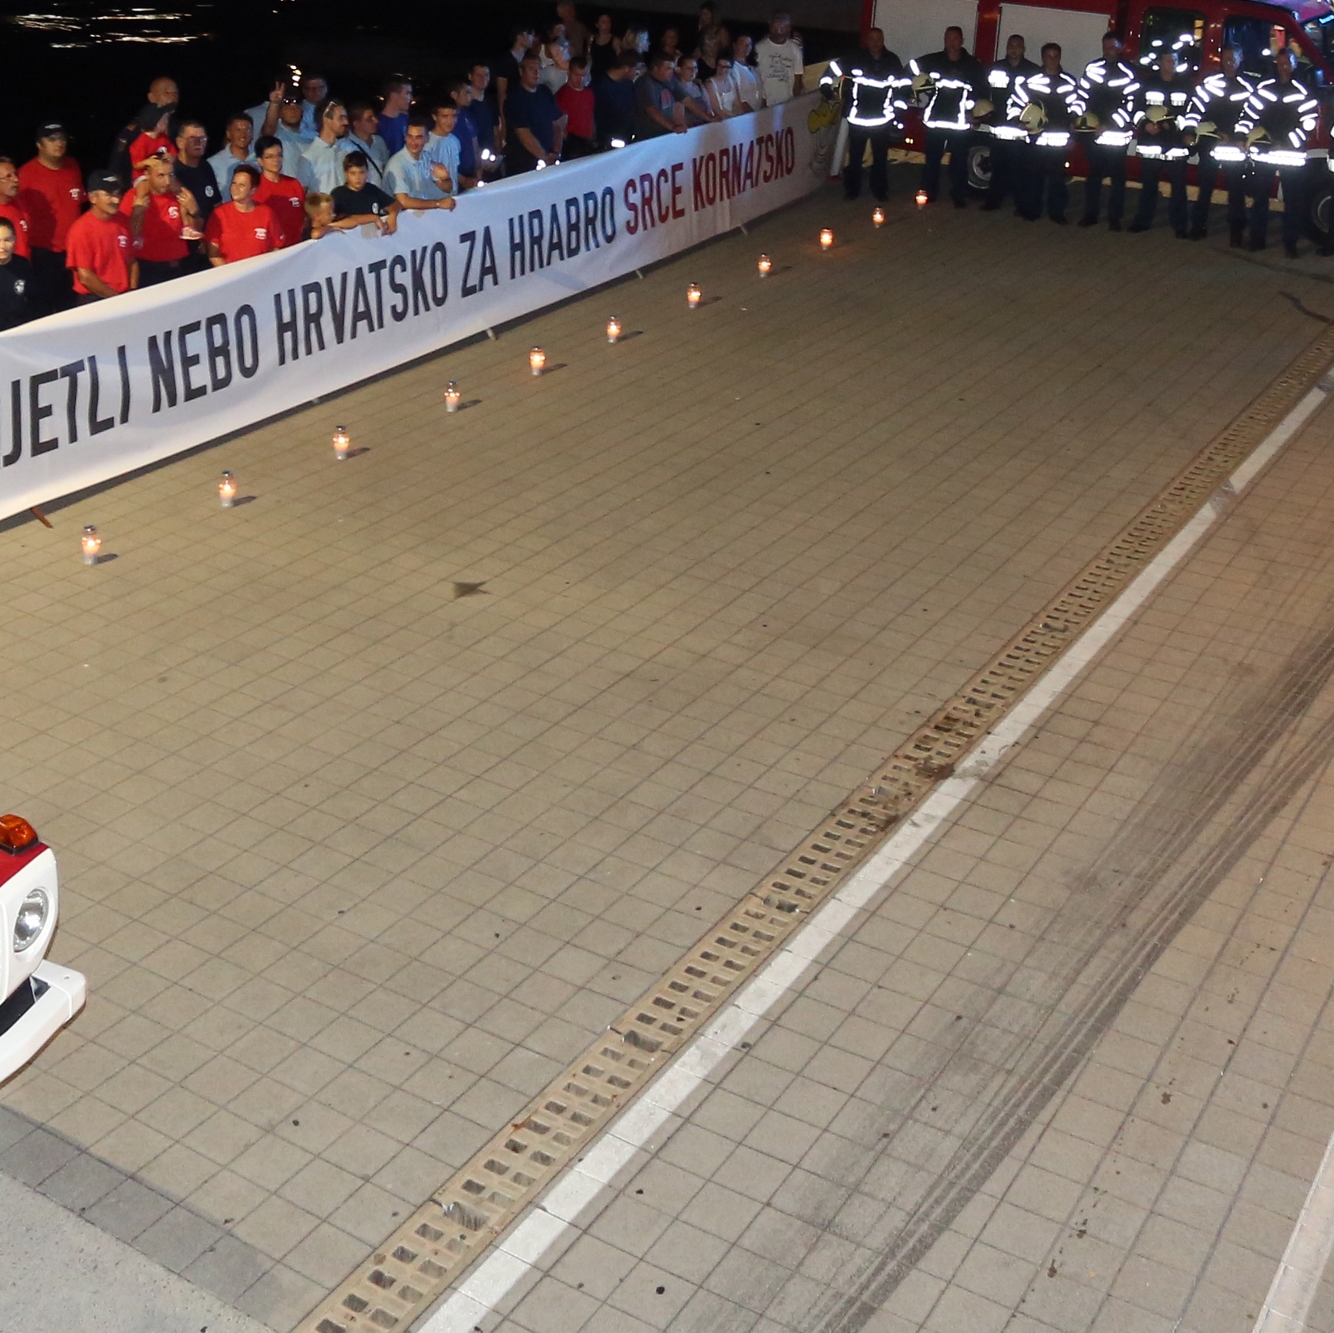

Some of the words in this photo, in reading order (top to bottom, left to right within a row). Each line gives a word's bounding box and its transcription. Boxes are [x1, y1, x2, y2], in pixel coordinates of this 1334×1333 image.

[147, 303, 260, 414] NEBO
[273, 240, 449, 366] HRVATSKO
[460, 224, 500, 300] ZA
[508, 185, 617, 280] HRABRO
[623, 161, 686, 236] SRCE
[692, 125, 796, 211] KORNATSKO
